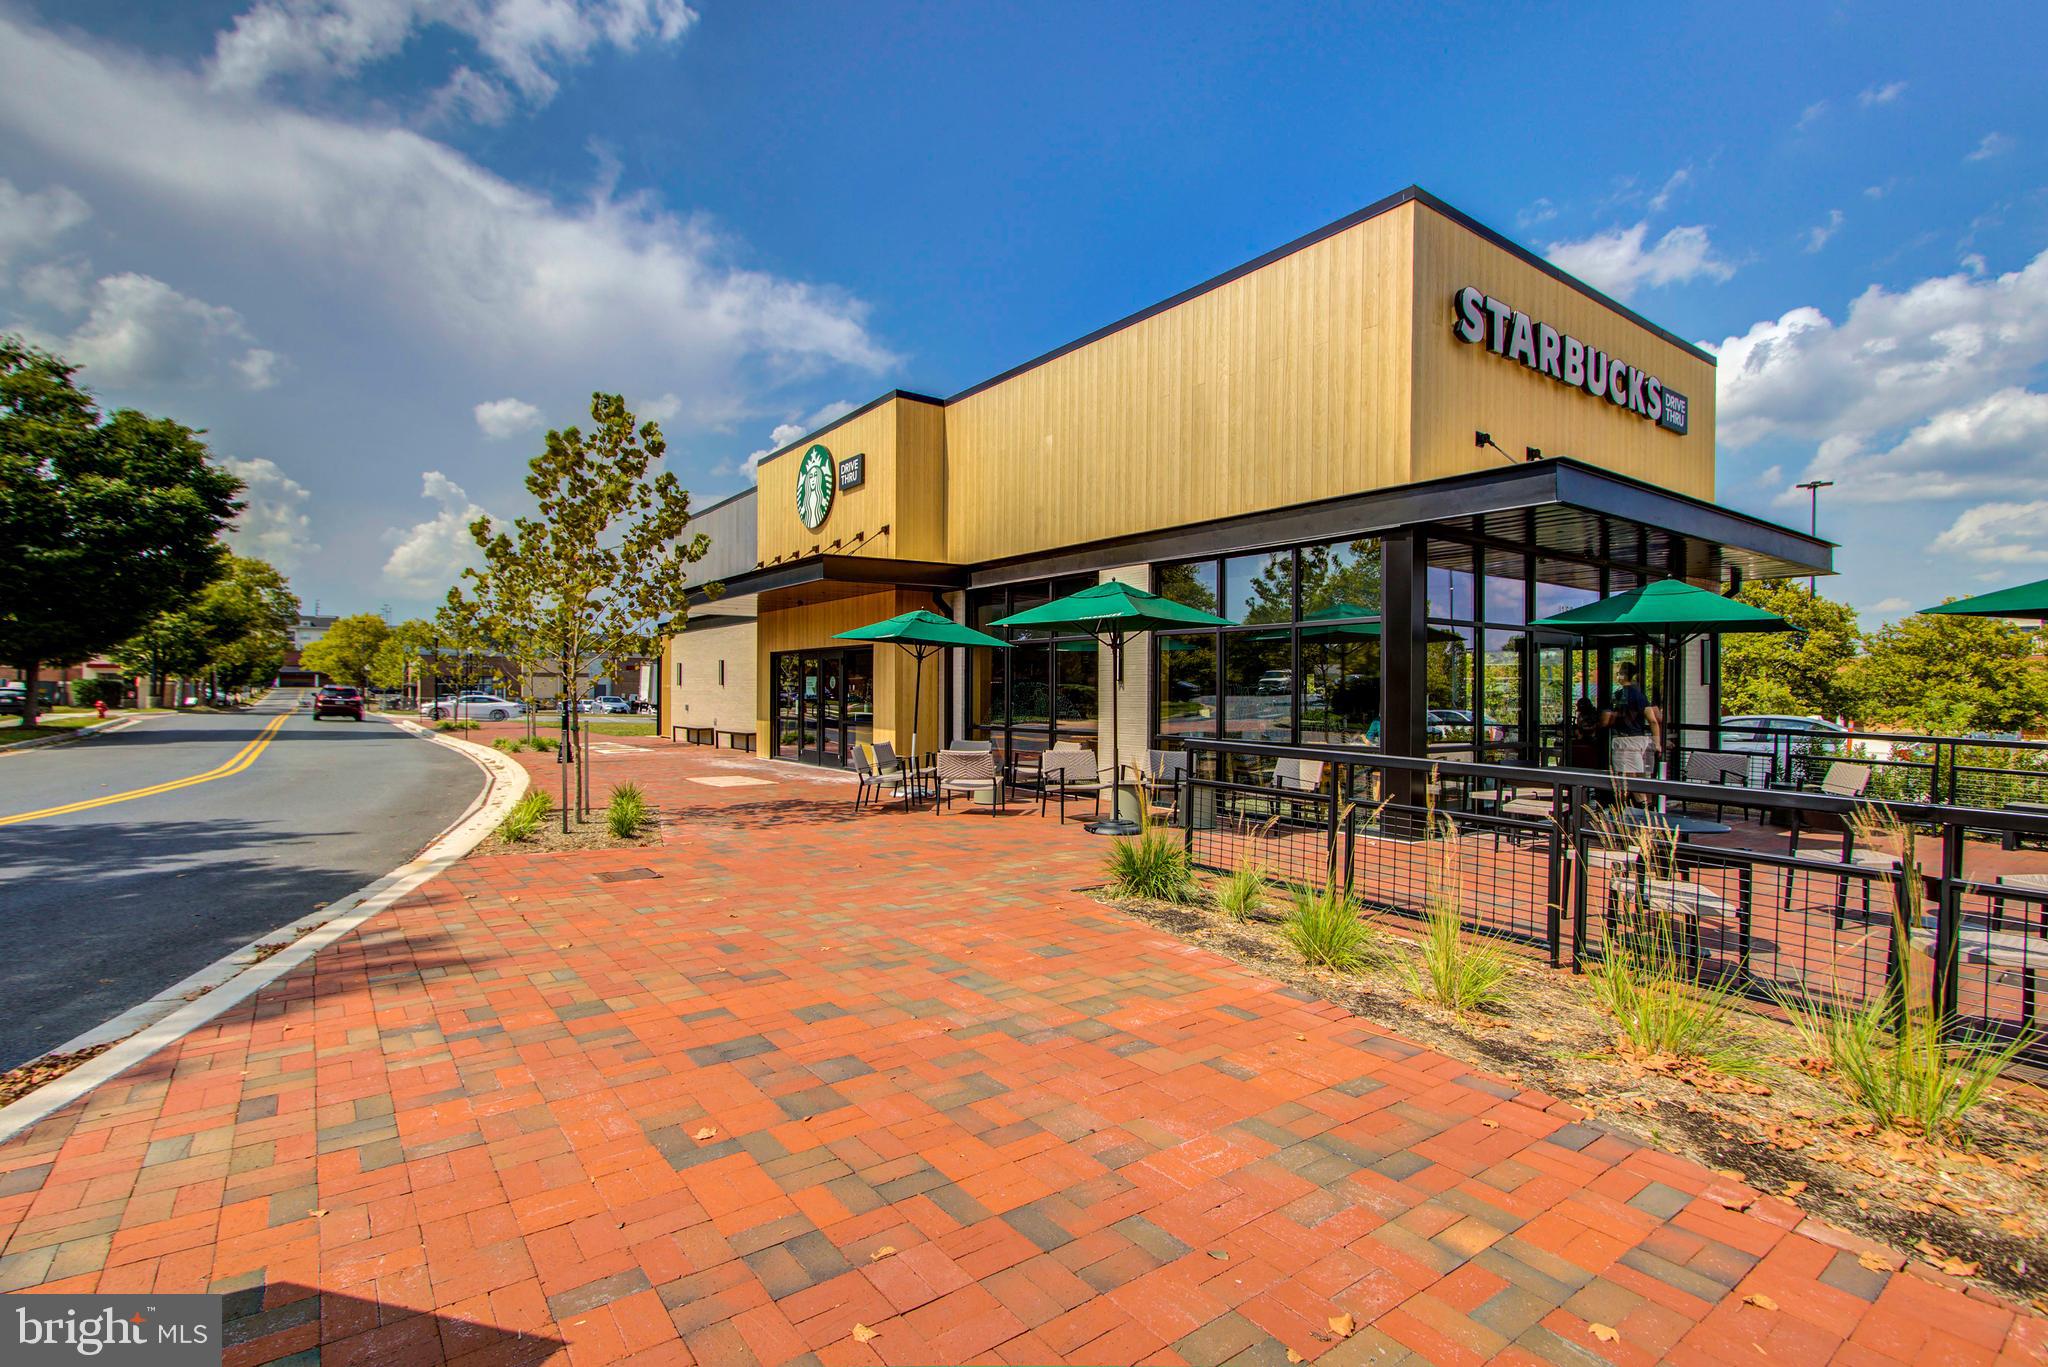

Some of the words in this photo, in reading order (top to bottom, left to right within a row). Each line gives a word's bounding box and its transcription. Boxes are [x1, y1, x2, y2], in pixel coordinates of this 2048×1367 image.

[1455, 286, 1662, 420] STARBUCKS
[1665, 393, 1686, 414] DRIVE
[1665, 408, 1685, 427] THRU
[840, 458, 859, 475] DRIVE
[840, 471, 858, 486] THRU
